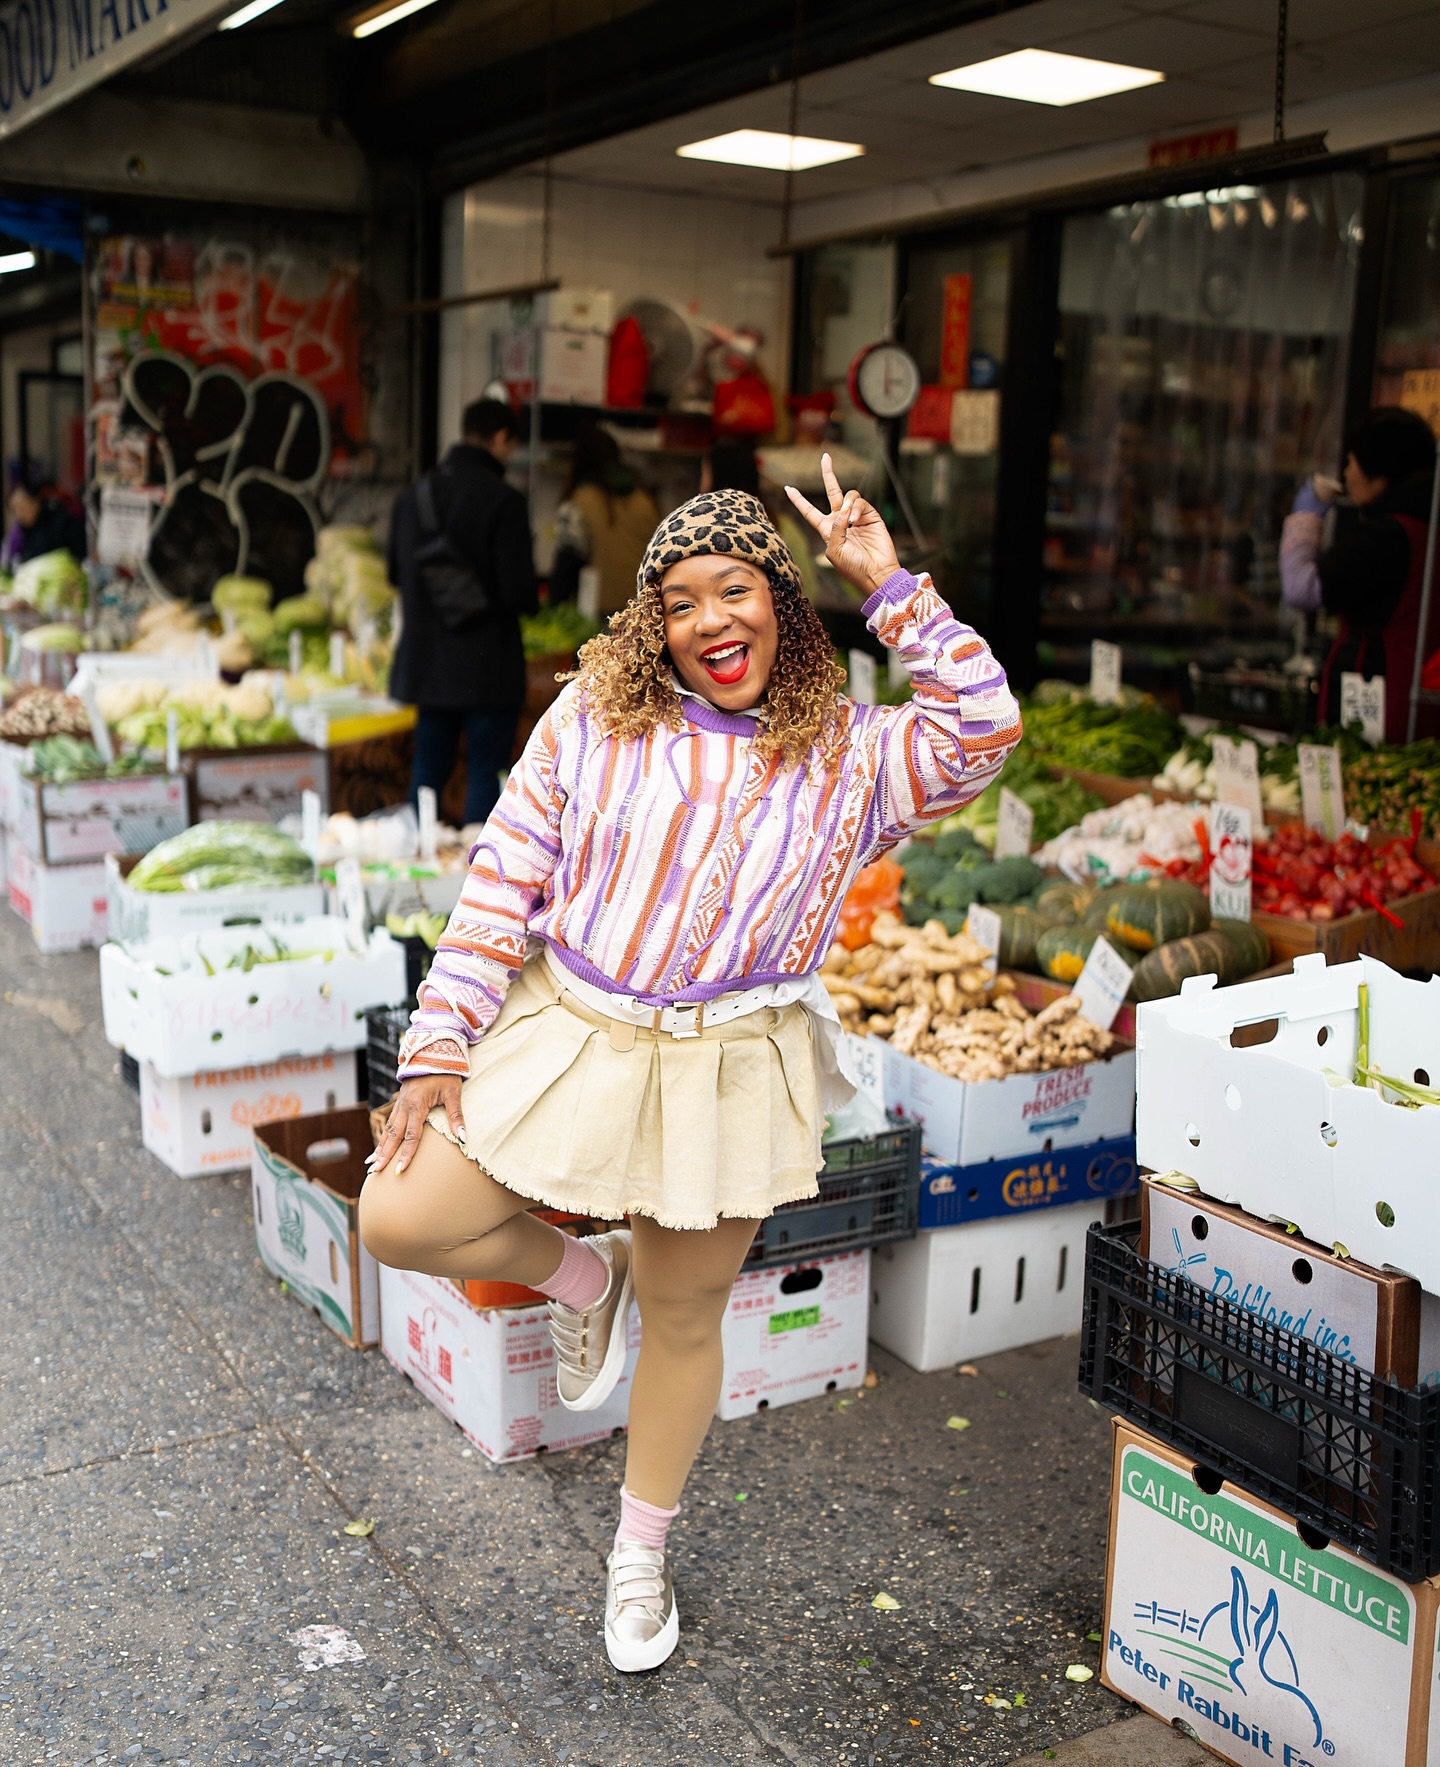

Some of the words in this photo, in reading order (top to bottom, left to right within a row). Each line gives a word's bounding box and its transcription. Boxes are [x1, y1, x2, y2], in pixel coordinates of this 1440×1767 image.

[193, 1063, 256, 1088] FRESH
[259, 1055, 334, 1079] GINGER
[1021, 1076, 1094, 1120] PRODUCE
[1035, 1064, 1085, 1097] FRESH
[1207, 1266, 1313, 1339] Delfland
[1127, 1470, 1270, 1568] CALIFORNIA
[1280, 1550, 1402, 1636] LETTUCE
[1109, 1630, 1171, 1690] Peter
[1178, 1678, 1274, 1759] Rabbit
